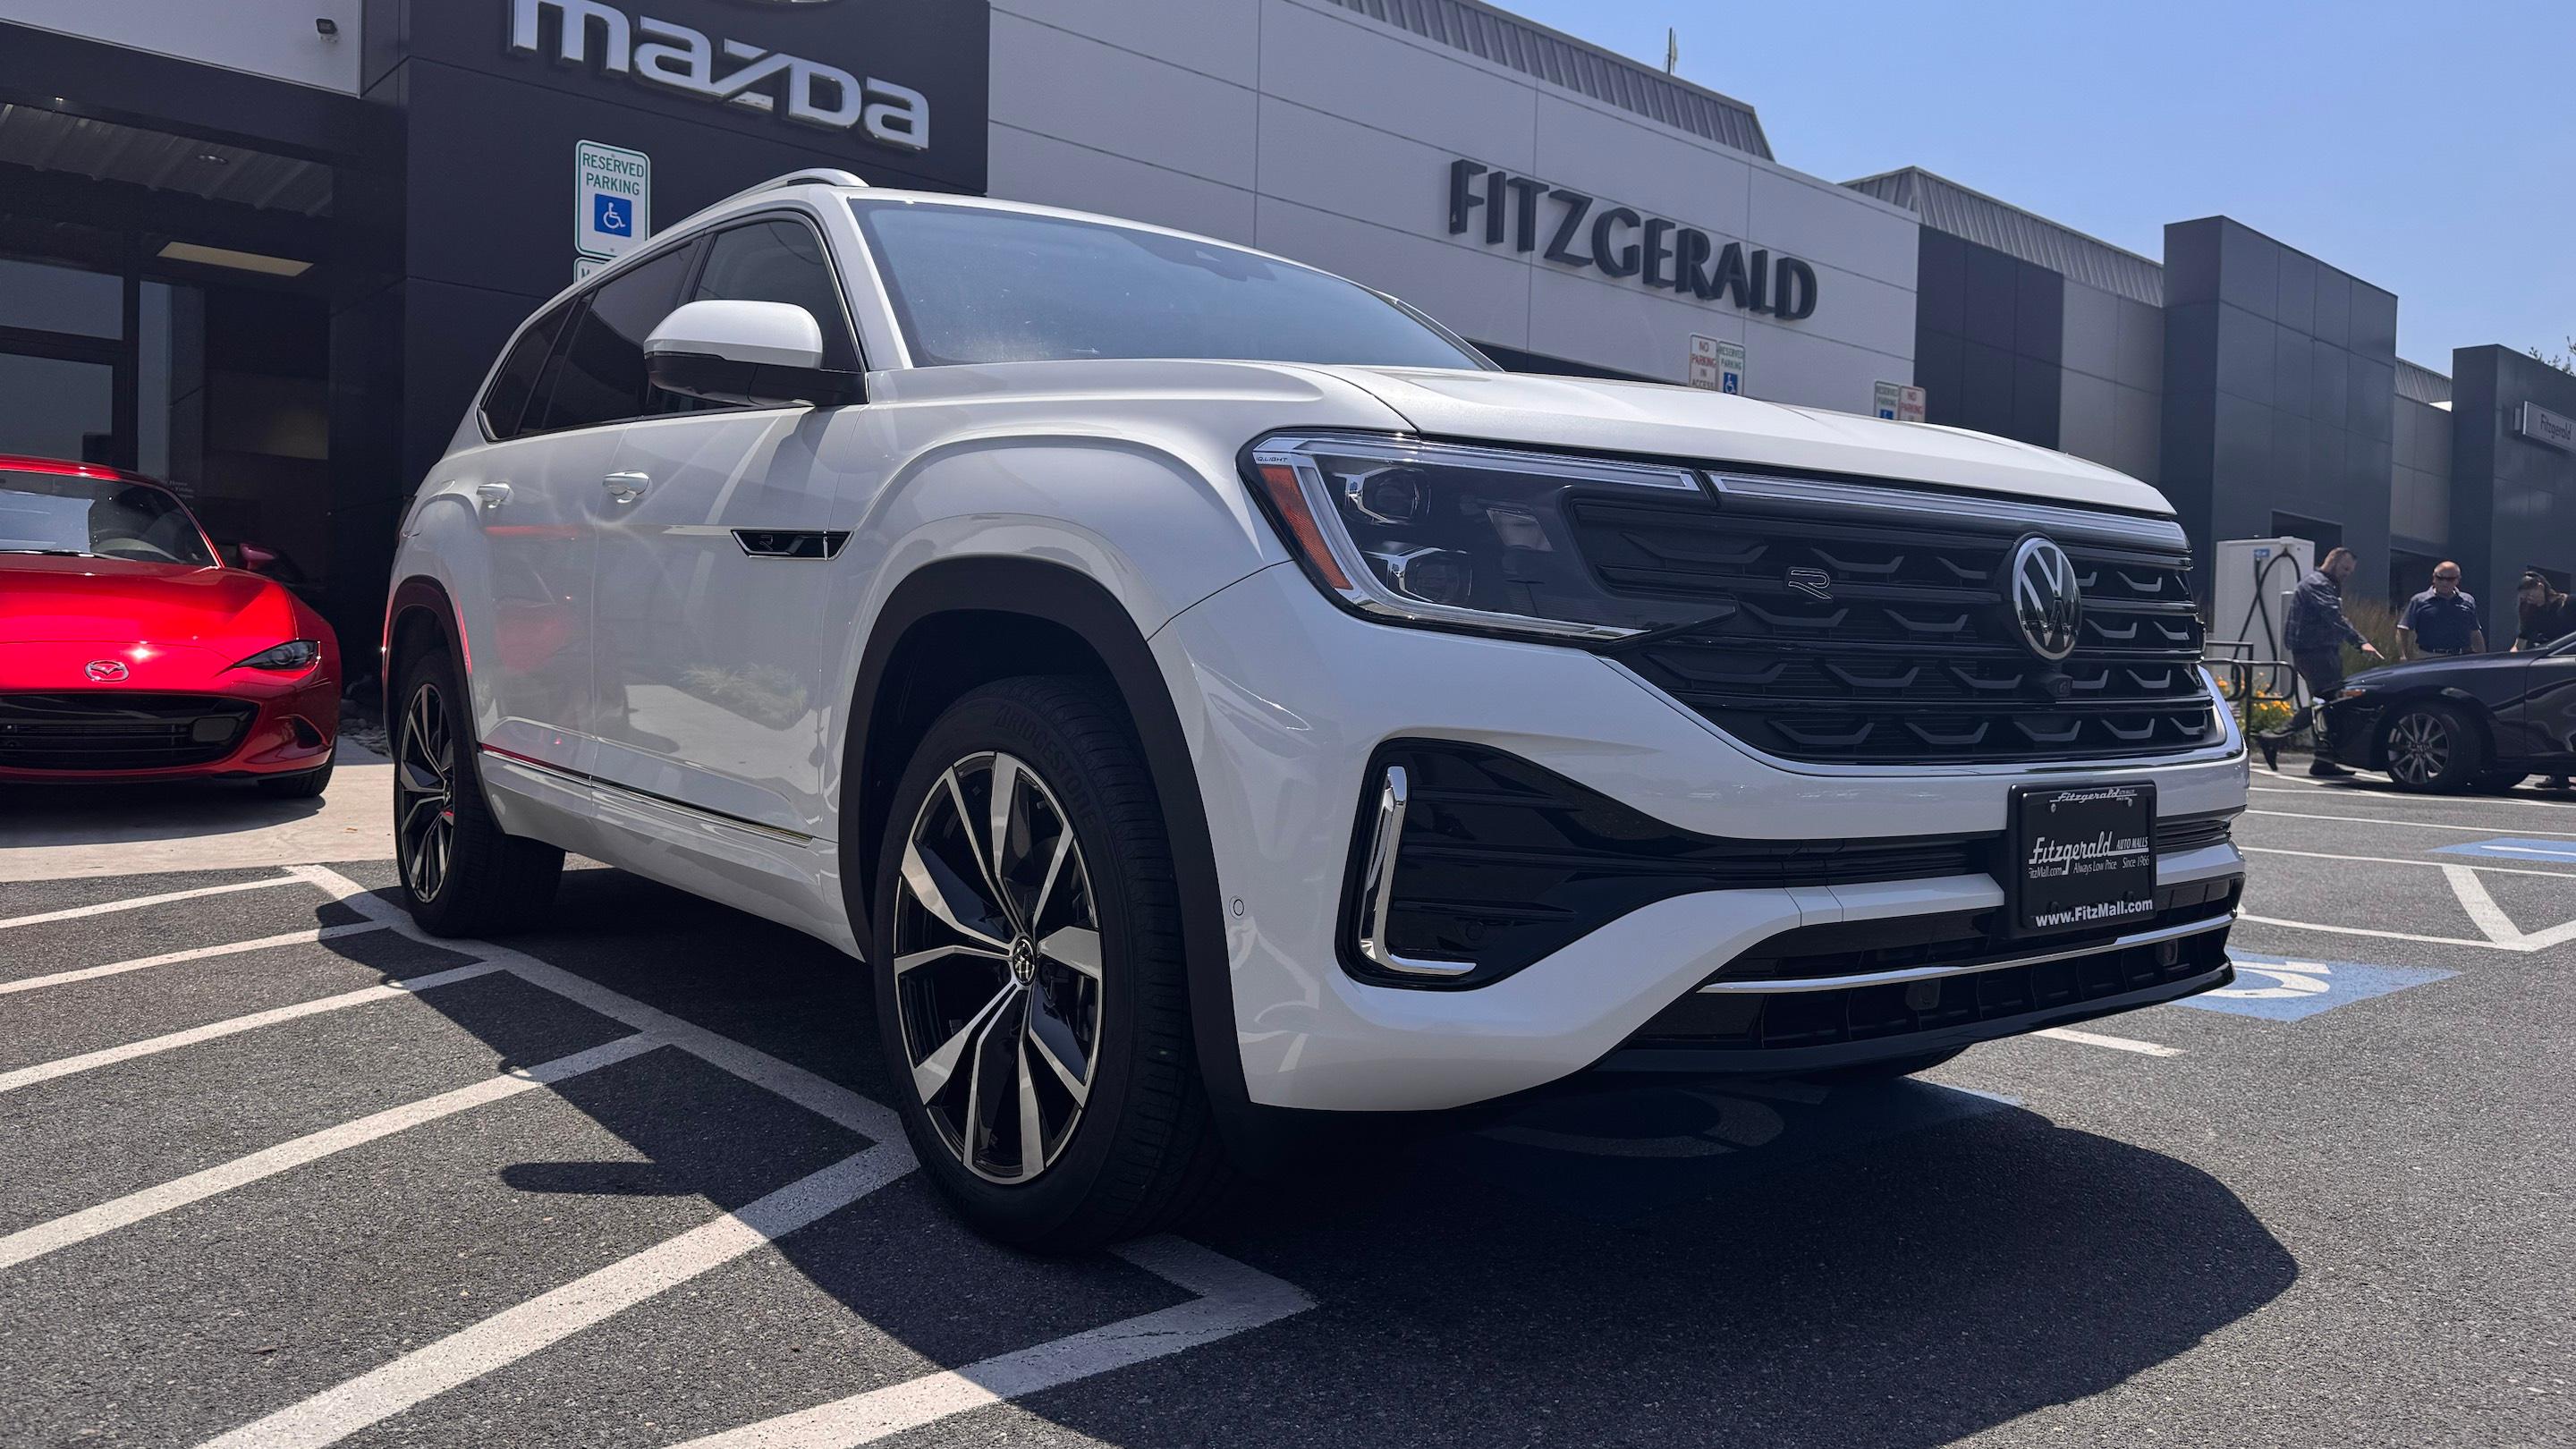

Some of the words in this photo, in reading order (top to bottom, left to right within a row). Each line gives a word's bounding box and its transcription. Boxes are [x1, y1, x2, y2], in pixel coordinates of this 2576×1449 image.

[582, 152, 644, 178] RESERVED
[586, 173, 640, 196] PARKING
[1448, 158, 1818, 320] FITZGERALD
[1699, 341, 1709, 353] NO
[1690, 354, 1717, 369] PARKING
[1721, 359, 1742, 371] PARKING
[2540, 413, 2572, 441] Fitzgerald
[1788, 566, 1834, 600] R
[2050, 788, 2121, 804] Fitzgerald
[2028, 830, 2114, 876] Fitzgerald
[2116, 838, 2131, 851] AUTO
[2131, 836, 2148, 848] MALLS
[2072, 862, 2093, 876] Always
[2093, 860, 2105, 872] Low
[2105, 860, 2117, 870] Price
[2122, 857, 2137, 869] Since
[2035, 898, 2154, 928] www.FitzMall.com
